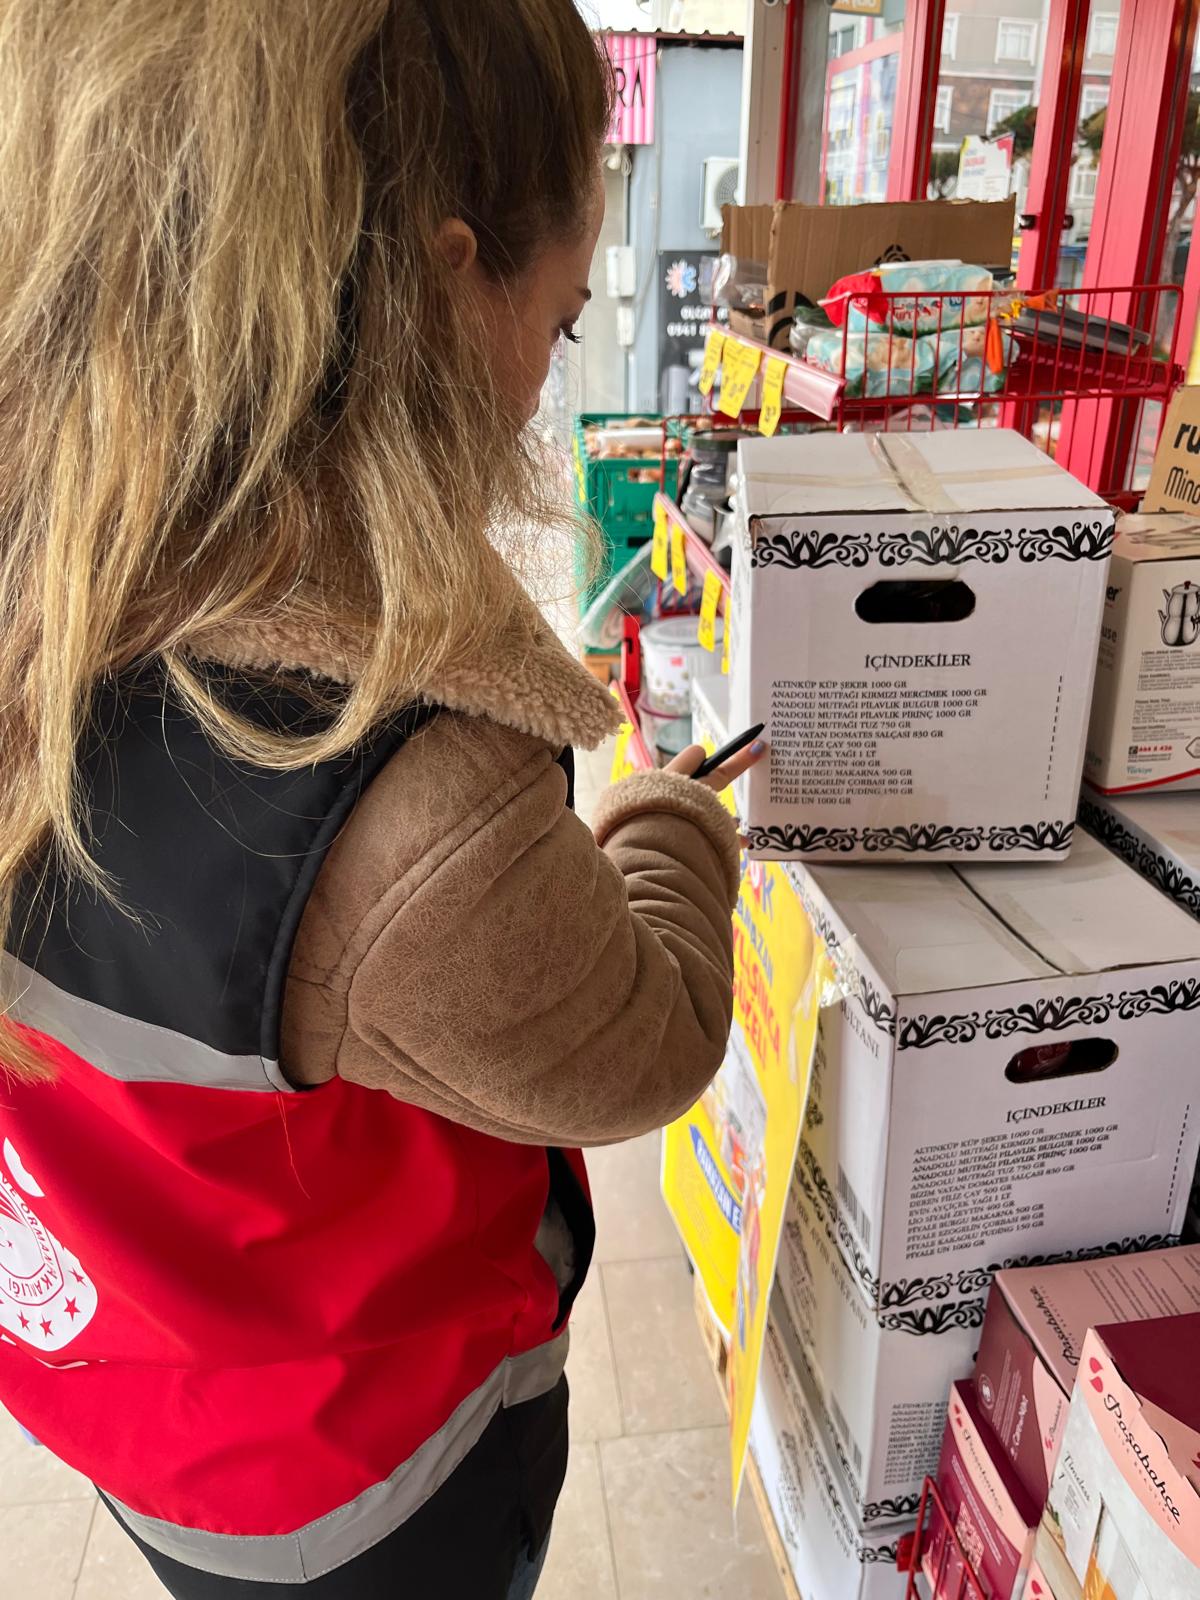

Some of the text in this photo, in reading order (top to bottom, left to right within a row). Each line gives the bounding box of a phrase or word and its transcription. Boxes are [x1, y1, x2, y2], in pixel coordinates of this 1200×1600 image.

[865, 653, 970, 671] İÇİNDEKİLER
[772, 680, 816, 688] ALTINKÜP
[819, 680, 837, 688] KÜP
[840, 681, 867, 690] ŞEKER
[772, 691, 816, 699] ANADOLU
[818, 690, 858, 699] MUTFAĞI
[861, 691, 896, 699] KIRMIZI
[900, 690, 948, 698] MERCİMEK
[771, 701, 815, 709] ANADOLU
[818, 700, 858, 709] MUTFAĞI
[861, 701, 899, 709] PİLAVLIK
[818, 710, 857, 718] MUTFAĞI
[902, 710, 933, 719] PİRİNÇ
[818, 720, 856, 729] MUTFAĞI
[875, 731, 910, 739] SALÇASI
[771, 740, 800, 748] DEREN
[802, 740, 824, 748] FİLİZ
[826, 741, 845, 749] ÇAY
[770, 749, 791, 757] EVİN
[794, 750, 831, 758] AYÇİÇEK
[835, 750, 856, 758] YAĞI
[866, 750, 876, 758] LT
[816, 759, 848, 767] ZEYTİN
[770, 777, 799, 785] PİYALE
[770, 786, 798, 794] PİYALE
[846, 787, 881, 795] PUDİNG
[770, 796, 798, 804] PİYALE
[1006, 1097, 1106, 1123] İÇİNDEKİLER
[1104, 1393, 1181, 1525] Paşabahçe
